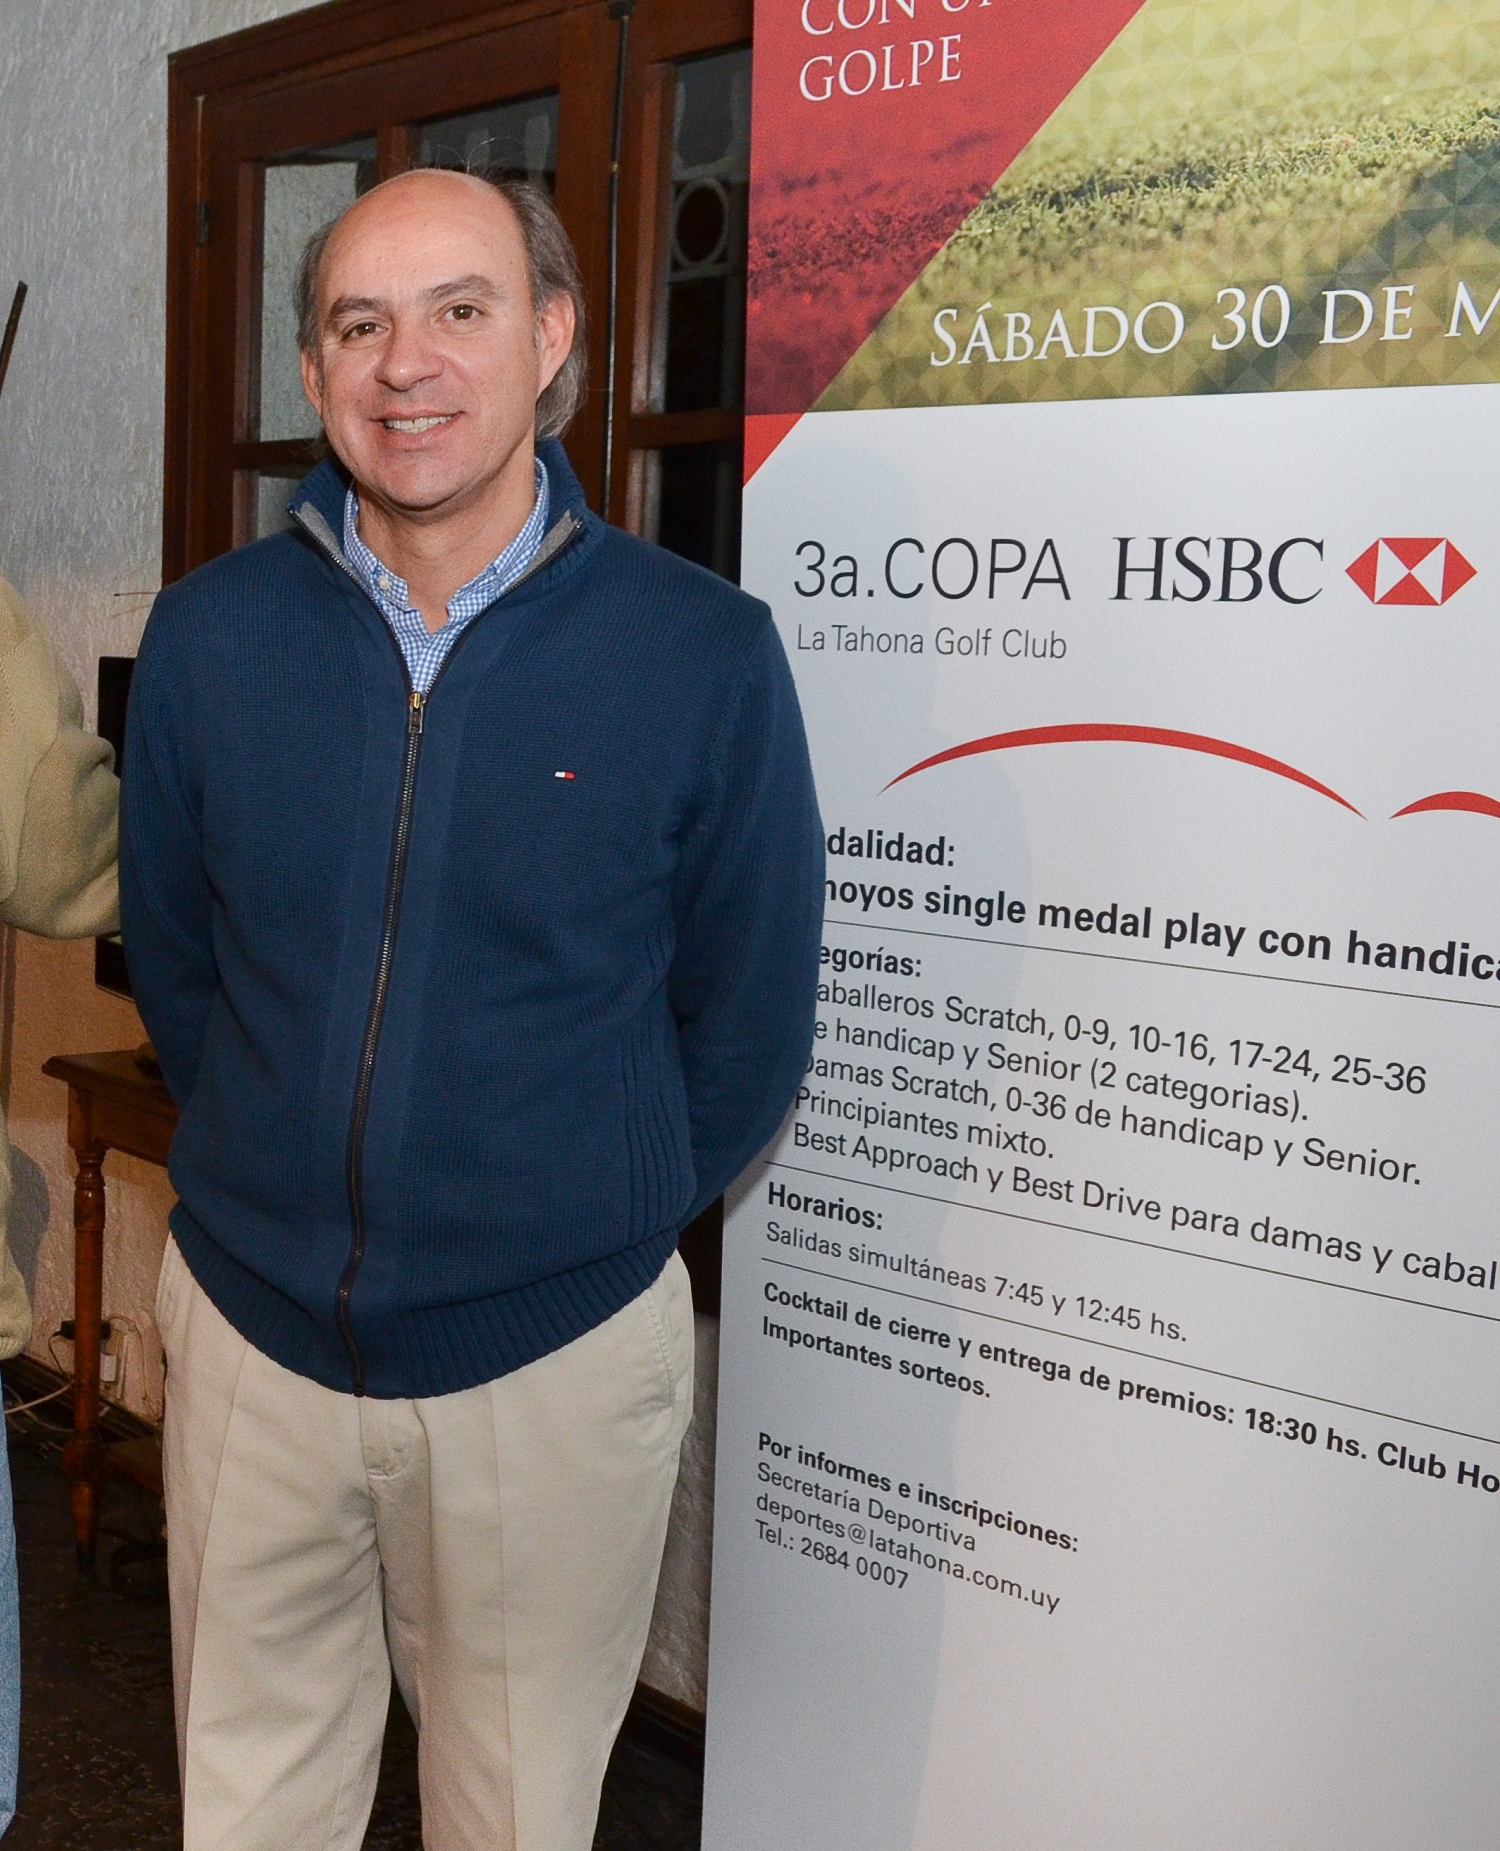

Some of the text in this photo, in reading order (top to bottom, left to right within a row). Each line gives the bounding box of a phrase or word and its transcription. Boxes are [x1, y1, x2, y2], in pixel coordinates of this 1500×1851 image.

[799, 33, 962, 102] GOLPE
[930, 301, 1184, 367] SÁBADO
[1211, 284, 1290, 351] 30
[1318, 284, 1415, 344] DE
[793, 536, 1325, 605] 3a.COPA HSBC
[797, 623, 1067, 660] La Tahona Golf Club
[924, 884, 1026, 928] single
[1038, 902, 1152, 939] medal
[1163, 911, 1247, 958] play
[1258, 929, 1331, 961] con
[1347, 929, 1500, 982] handic
[836, 1017, 955, 1066] handicap
[962, 1044, 980, 1071] y
[987, 1042, 1082, 1082] Senior
[1090, 1057, 1117, 1090] (2
[1125, 1072, 1308, 1124] categorias).
[944, 995, 1055, 1042] Scratch,
[1064, 1014, 1117, 1051] 0-9,
[1129, 1024, 1216, 1067] 10-16,
[1229, 1039, 1321, 1083] 17-24,
[1331, 1054, 1427, 1095] 25-36
[794, 1085, 1054, 1159] Principiantes mixto.
[891, 1065, 997, 1112] Scratch,
[1005, 1086, 1067, 1121] 0-36
[1074, 1098, 1111, 1129] de
[1120, 1104, 1264, 1161] handicap
[1273, 1139, 1294, 1167] y
[1302, 1137, 1421, 1186] Senior.
[768, 1181, 883, 1233] Horarios:
[794, 1122, 1498, 1291] Best Approach y Best Drive para damas y cabal
[766, 1221, 1187, 1343] Salidas simultáneas 7:45 y 12:45 hs.
[762, 1314, 991, 1399] Importantes sorteos.
[764, 1281, 1500, 1493] Cocktail de cierre y entrega de premios: 18:30 hs. Club Ho
[756, 1459, 979, 1553] Secretaría Deportiva
[758, 1431, 1079, 1553] Por informes e inscripciones:
[754, 1490, 1061, 1615] deportes@latahona.com.uy
[754, 1518, 909, 1589] Tel.: 2684 0007
